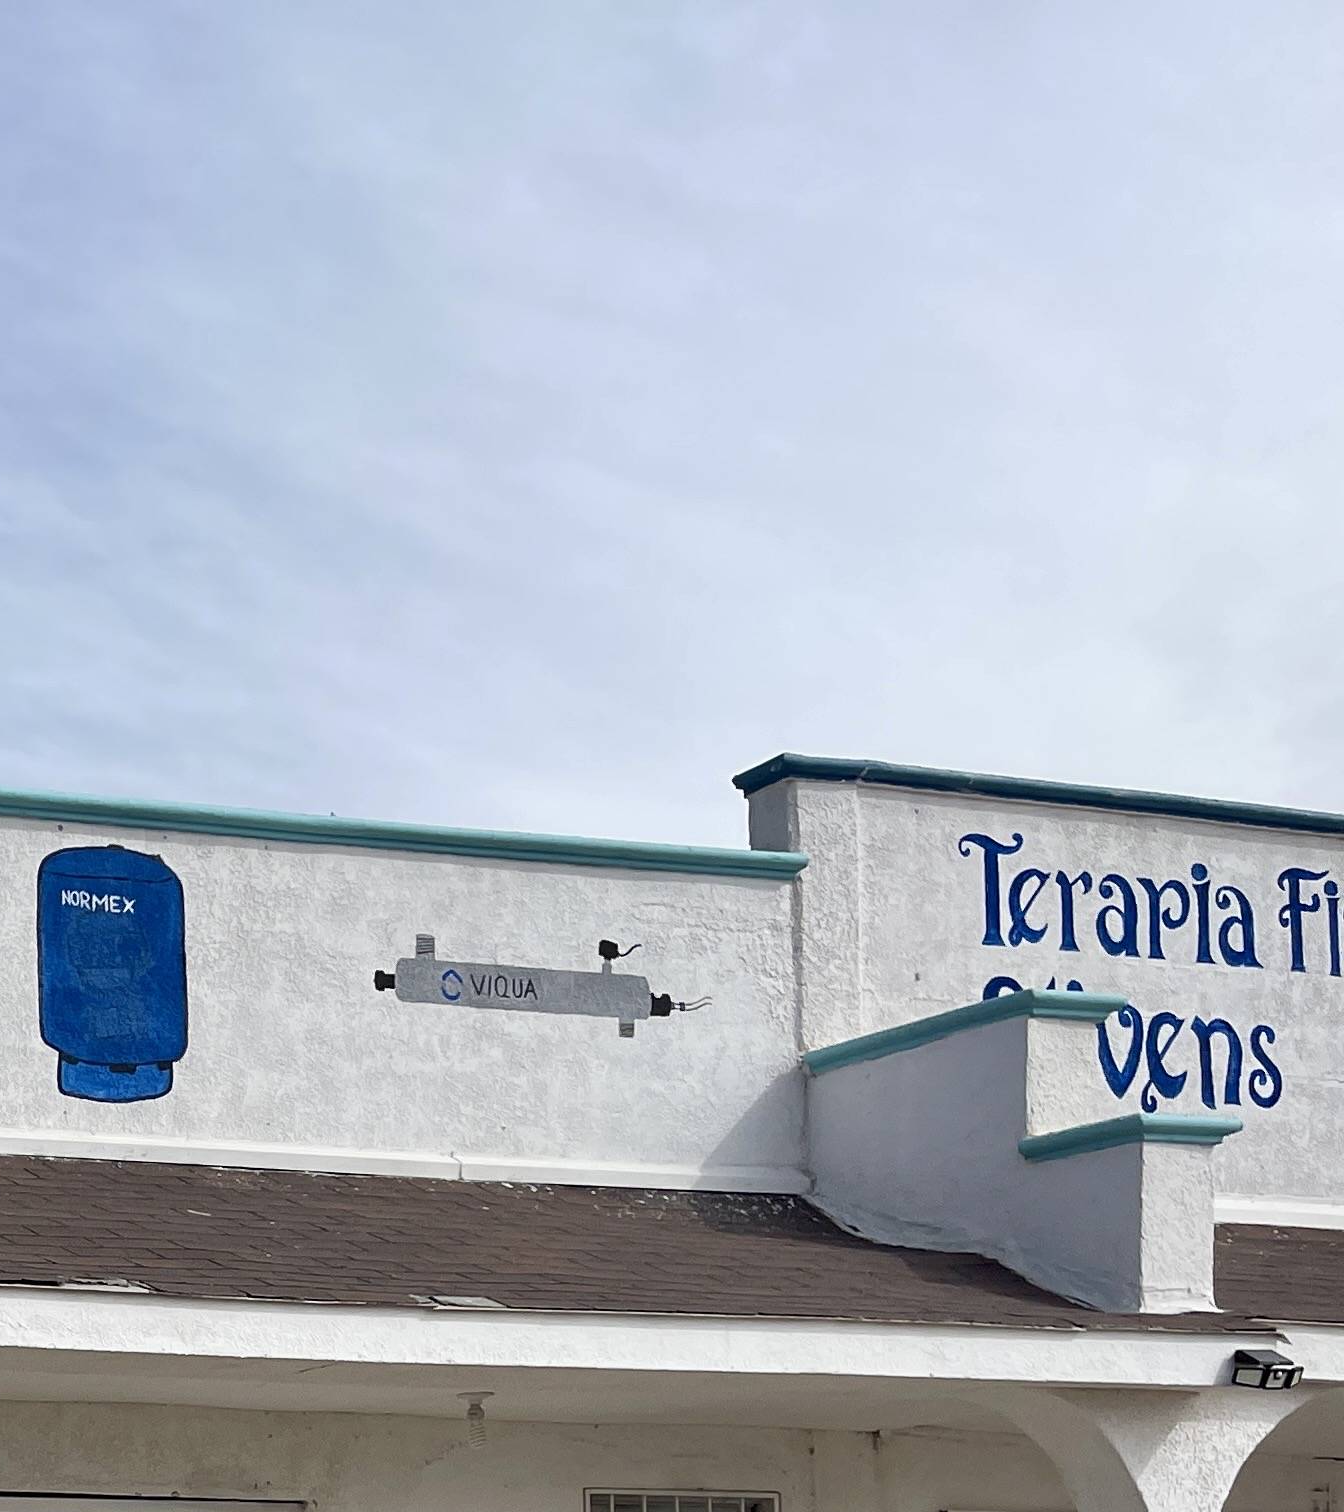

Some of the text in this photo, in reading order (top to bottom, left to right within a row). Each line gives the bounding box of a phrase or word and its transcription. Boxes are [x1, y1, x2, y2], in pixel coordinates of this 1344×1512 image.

[61, 890, 136, 914] NORMEX
[958, 832, 1344, 977] Terapia Fi
[469, 973, 539, 1001] VIQUA
